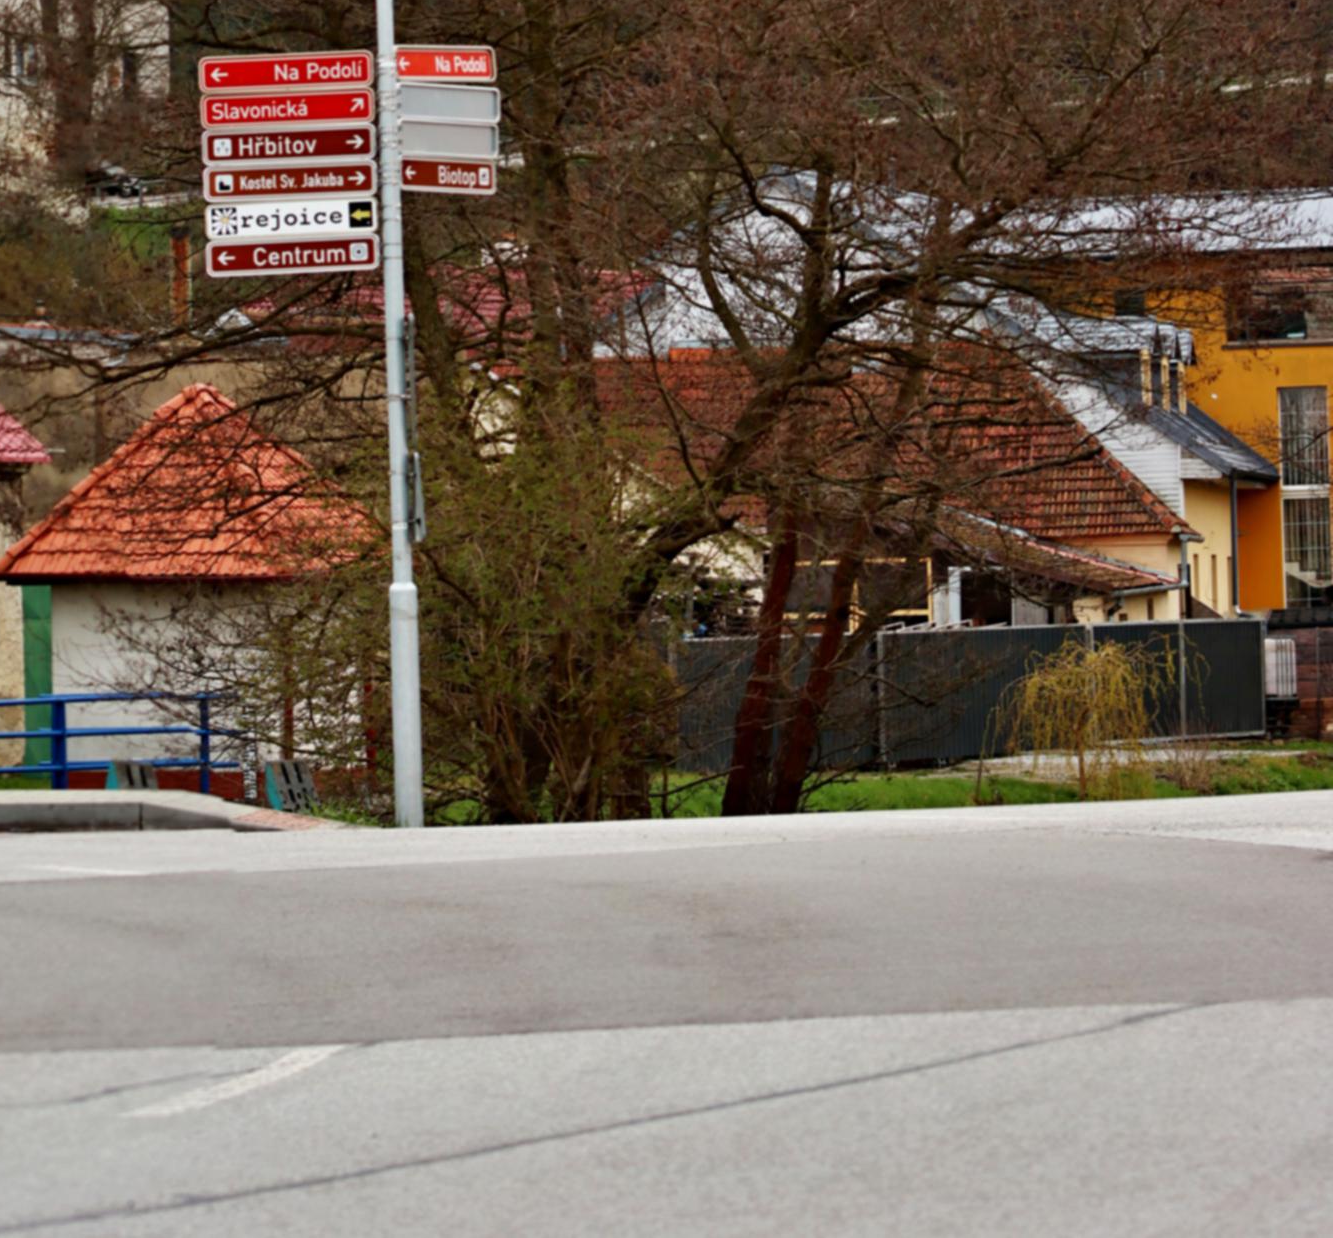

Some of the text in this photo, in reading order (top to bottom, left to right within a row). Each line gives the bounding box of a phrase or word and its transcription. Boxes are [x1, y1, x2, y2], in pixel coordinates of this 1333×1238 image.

[274, 60, 363, 81] Na Podolí
[434, 56, 451, 73] Na
[211, 98, 309, 121] Slavonická
[238, 136, 318, 157] Hřbitov
[239, 171, 345, 191] Kostel Sv. Jakuba
[437, 164, 477, 187] Biotop
[241, 208, 343, 232] rejoice
[252, 244, 347, 267] Centrum
